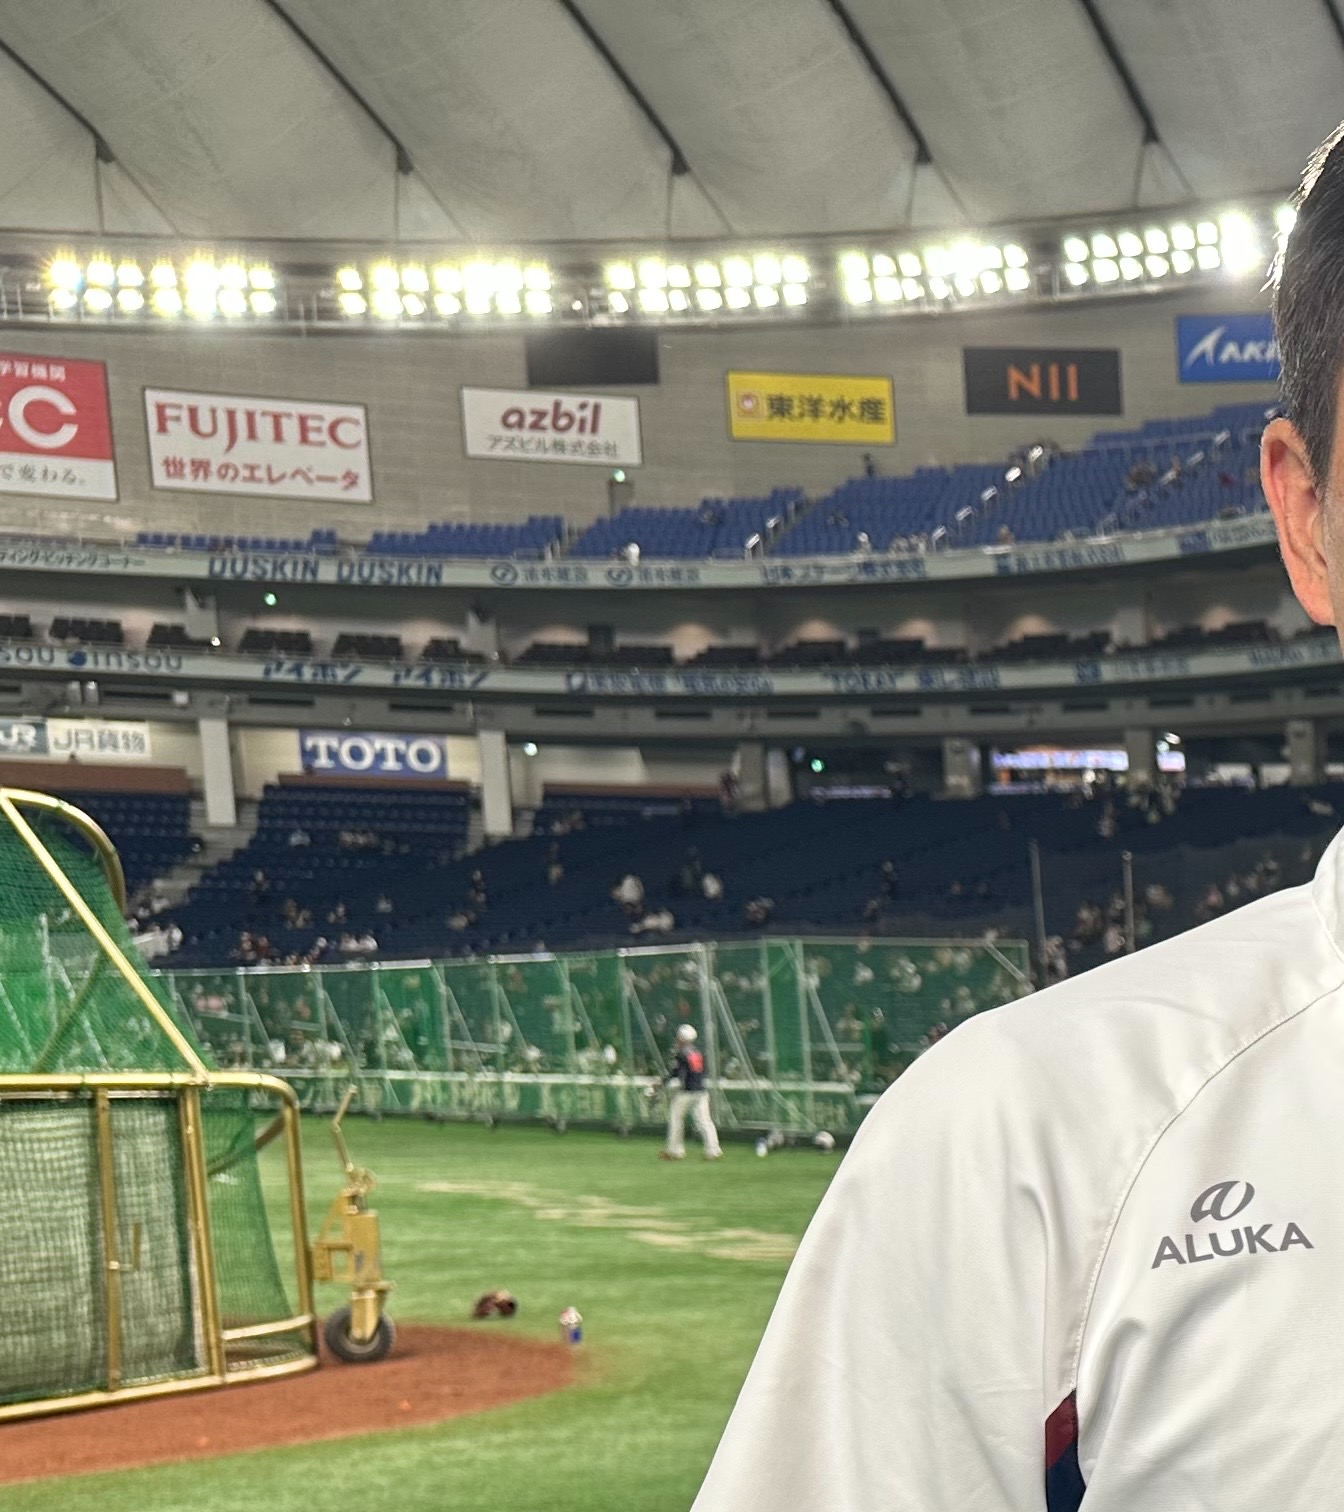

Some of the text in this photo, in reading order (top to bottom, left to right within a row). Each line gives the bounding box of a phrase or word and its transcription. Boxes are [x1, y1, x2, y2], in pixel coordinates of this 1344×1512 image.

[501, 400, 601, 435] azbil
[767, 391, 886, 425] 東洋水産
[155, 402, 362, 452] FUJITEC
[163, 456, 360, 490] 世界のエレベータ
[209, 557, 443, 584] DUSKIN DUSKIN
[305, 734, 443, 773] TOTO
[1151, 1223, 1314, 1268] ALUKA
